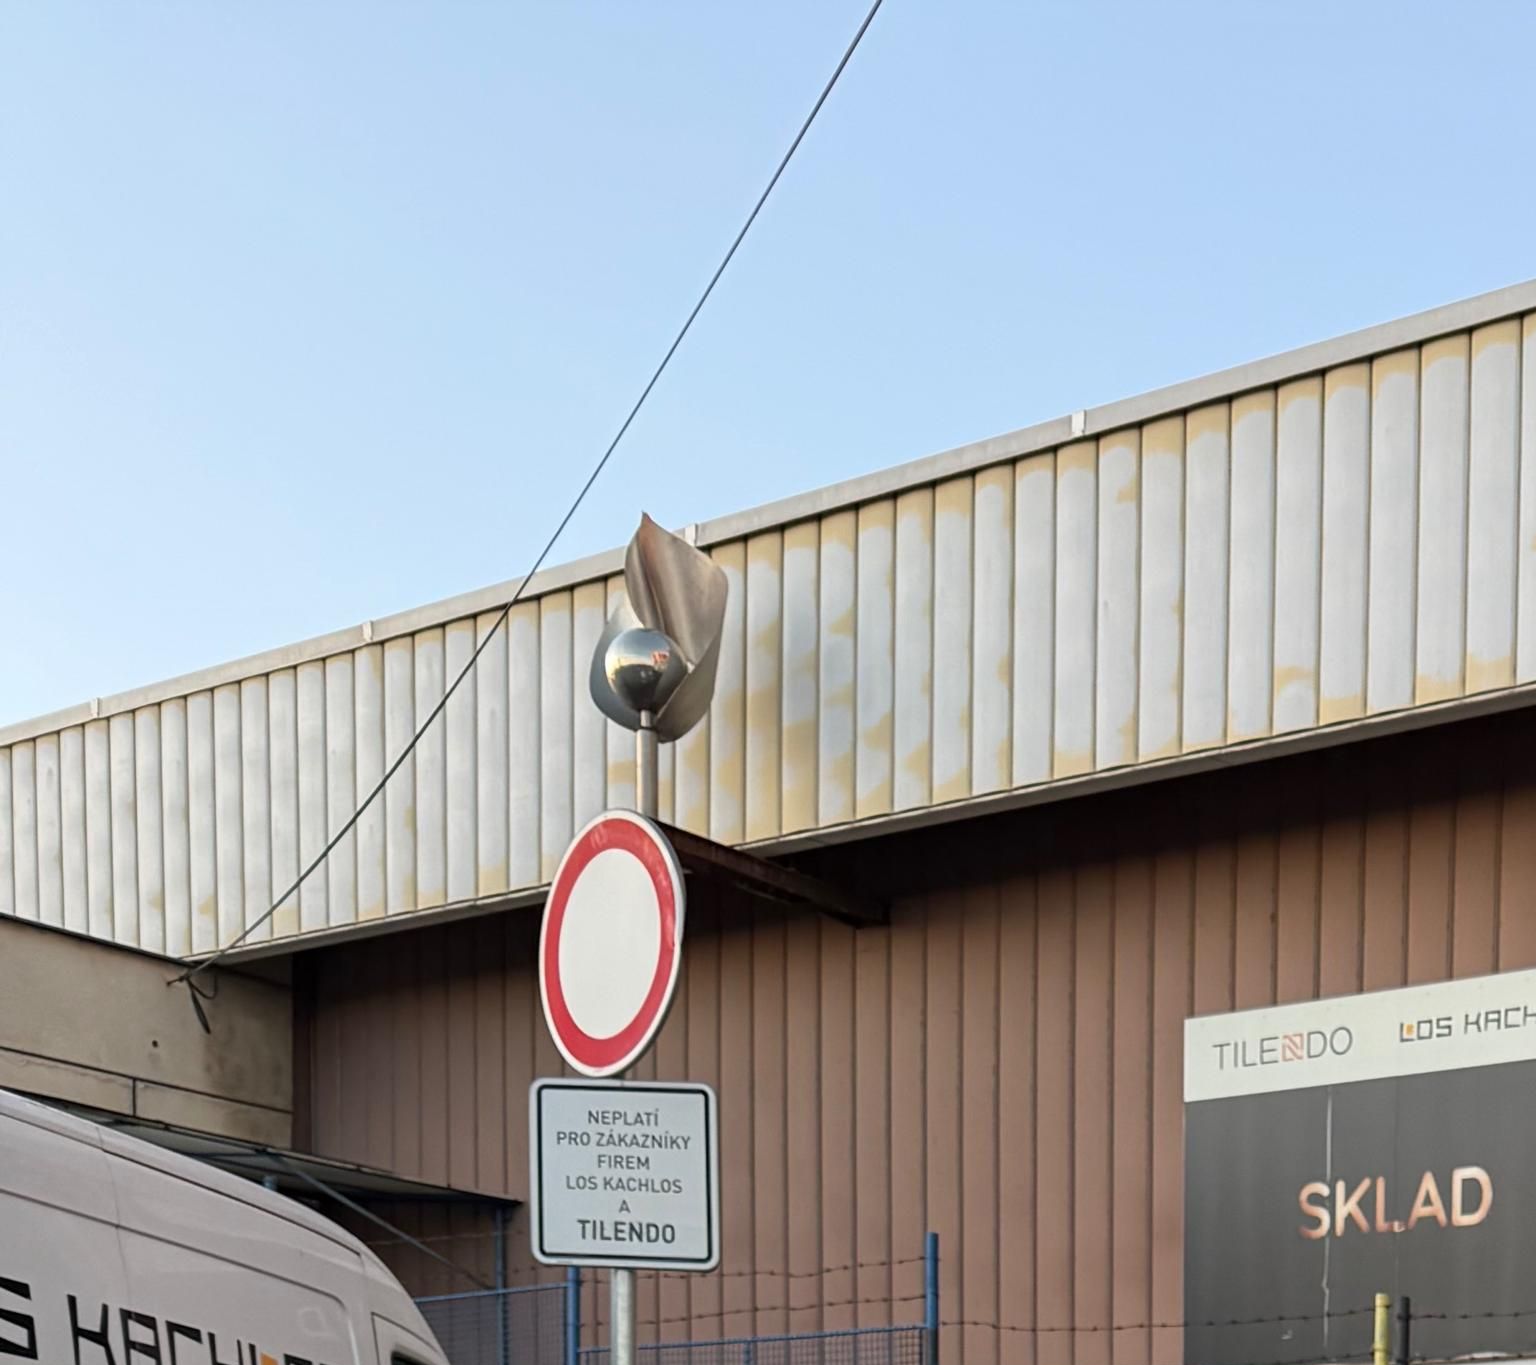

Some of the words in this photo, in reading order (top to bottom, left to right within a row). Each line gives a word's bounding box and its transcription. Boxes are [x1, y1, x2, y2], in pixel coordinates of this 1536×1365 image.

[1400, 1017, 1453, 1043] LOS
[1212, 1026, 1353, 1070] TILENDO
[588, 1108, 660, 1127] NEPLATÍ
[556, 1131, 591, 1146] PRO
[595, 1129, 691, 1150] ZÁKAZNÍKY
[597, 1154, 651, 1170] FIREM
[566, 1175, 598, 1191] LOS
[603, 1176, 683, 1194] KACHLOS
[618, 1199, 631, 1214] A
[1298, 1166, 1494, 1239] SKLAD
[577, 1218, 676, 1244] TILENDO
